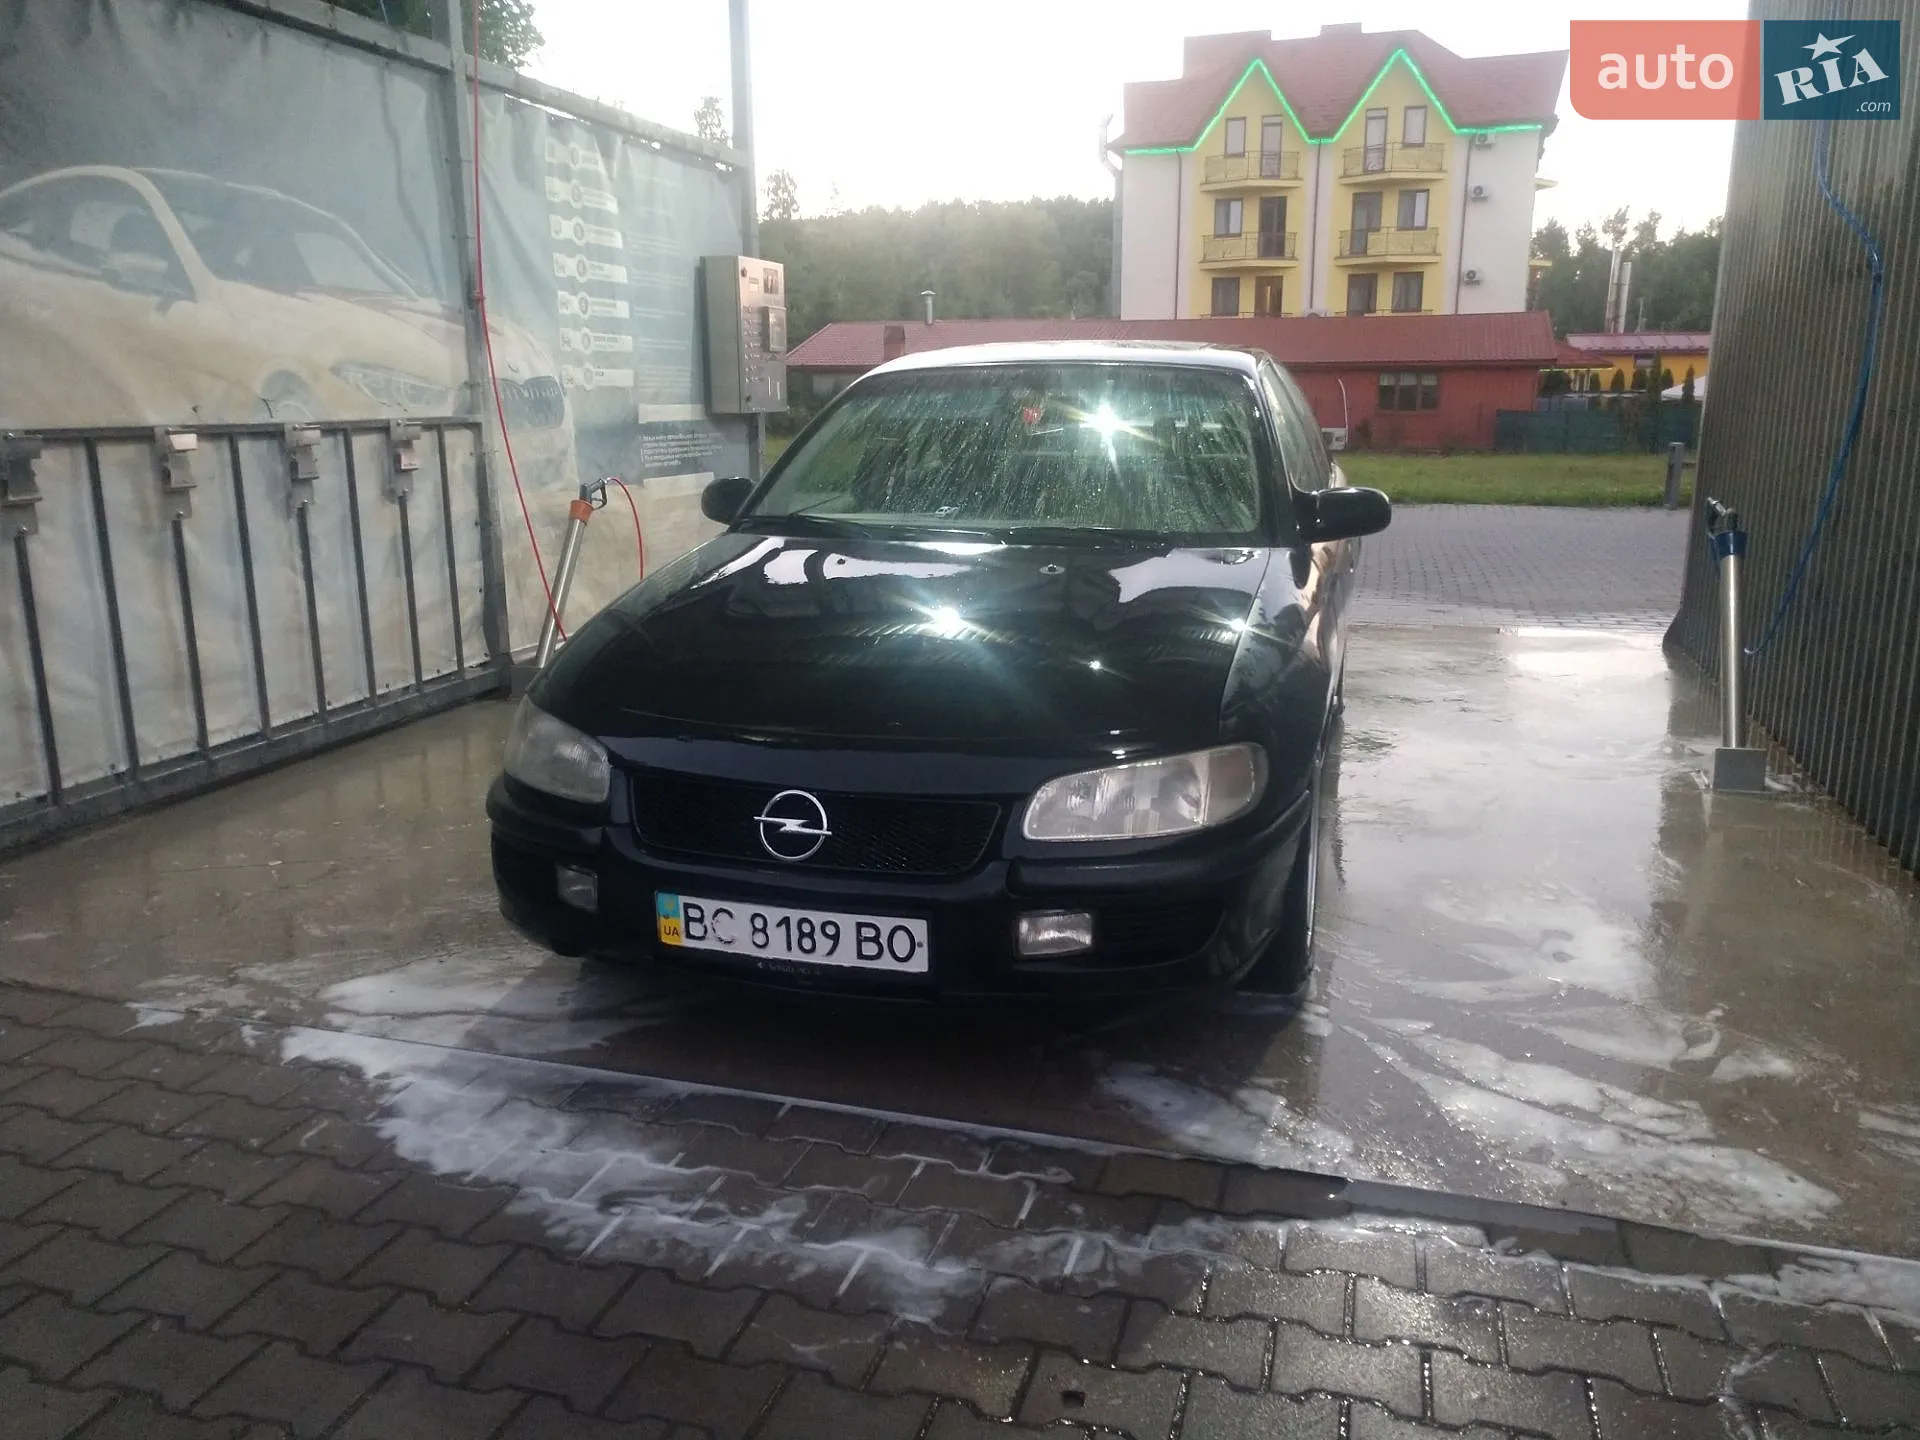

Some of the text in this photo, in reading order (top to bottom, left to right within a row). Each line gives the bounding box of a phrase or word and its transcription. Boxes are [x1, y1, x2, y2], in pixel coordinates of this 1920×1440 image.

[663, 925, 680, 938] UA
[682, 902, 917, 963] BC 8189 BO
